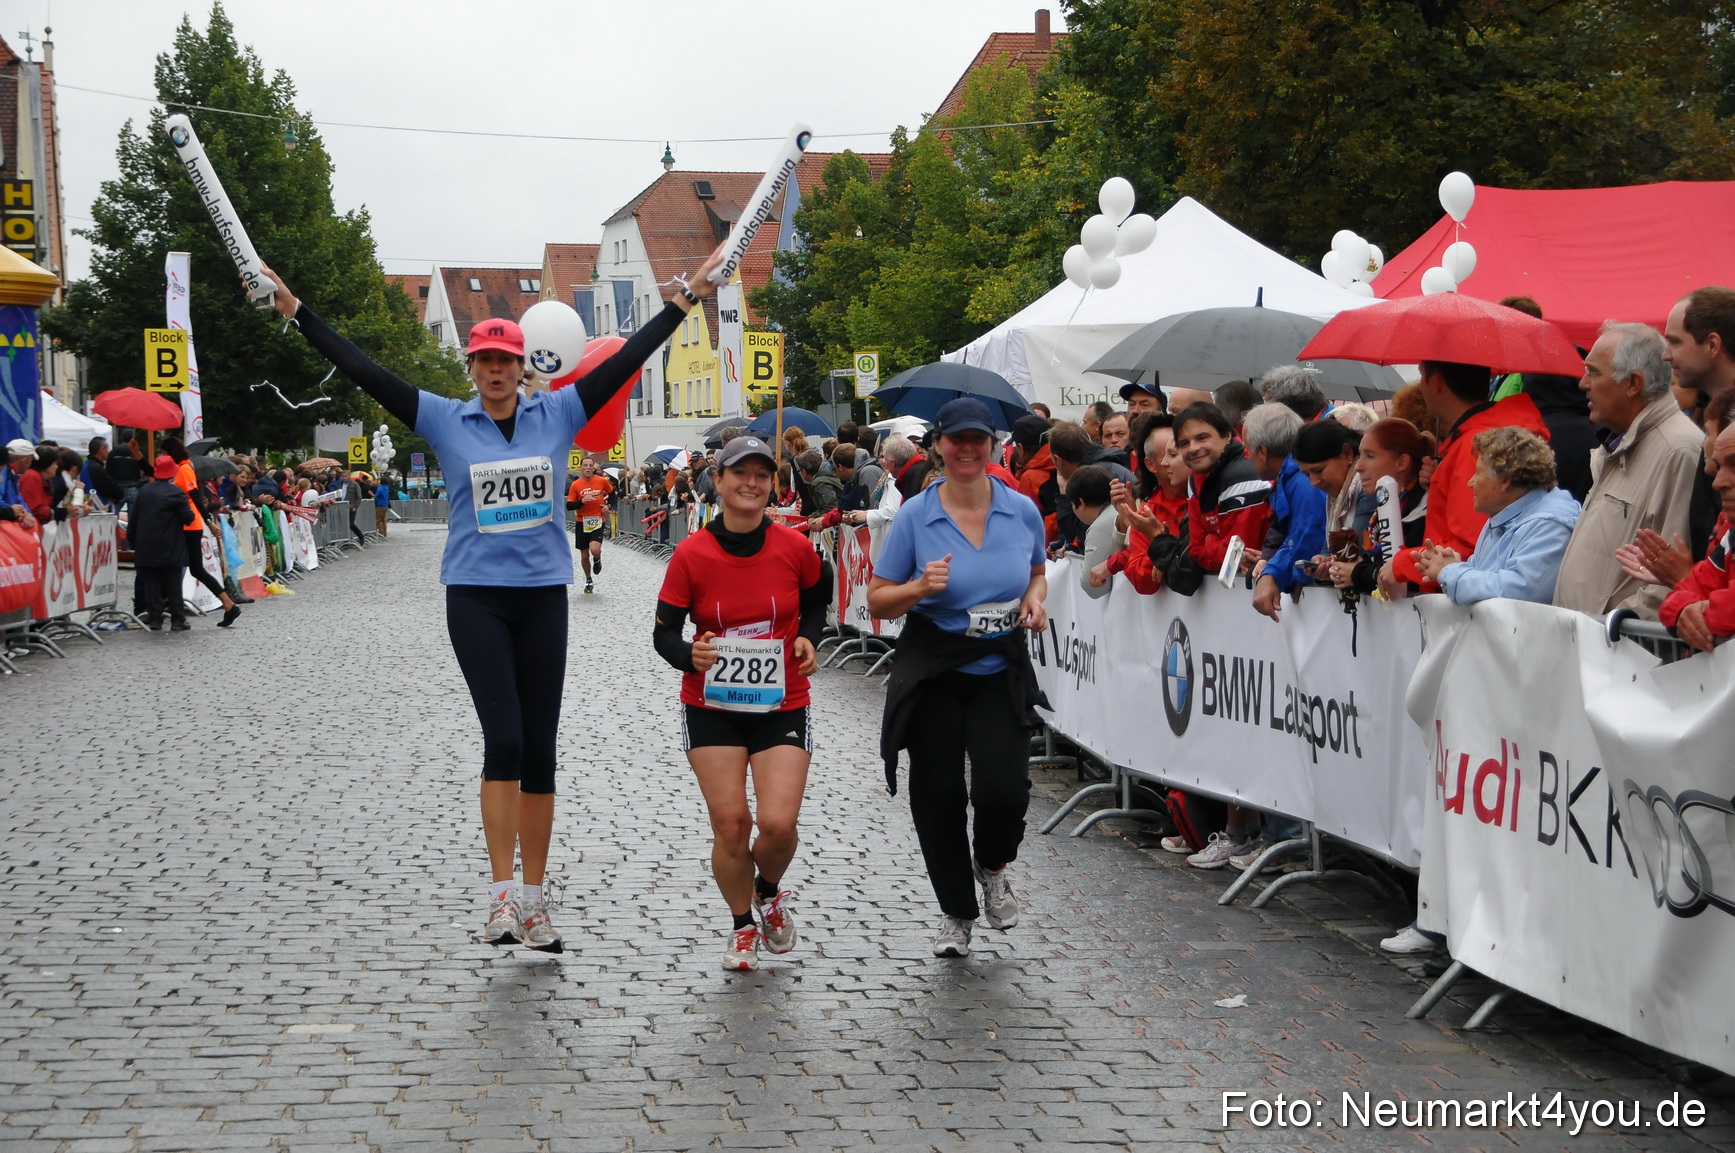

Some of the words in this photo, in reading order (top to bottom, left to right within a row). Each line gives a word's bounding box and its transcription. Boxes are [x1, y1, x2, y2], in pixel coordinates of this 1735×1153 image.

[185, 157, 259, 292] bmw-laufsport.de
[150, 332, 183, 343] Block
[748, 334, 779, 347] Block
[531, 350, 560, 361] BMW
[157, 348, 178, 378] B
[753, 351, 773, 380] B
[353, 444, 362, 458] C
[612, 443, 621, 455] C
[572, 456, 579, 465] D
[473, 469, 500, 478] PARTL
[501, 464, 538, 475] Neumarkt
[481, 474, 546, 505] 2409
[495, 507, 537, 522] Cornelia
[737, 627, 758, 636] DEHN
[735, 645, 771, 654] Neumarkt
[714, 656, 777, 685] 2282
[1202, 652, 1264, 726] BMW
[727, 690, 761, 703] Margit
[1435, 719, 1521, 832] Audi
